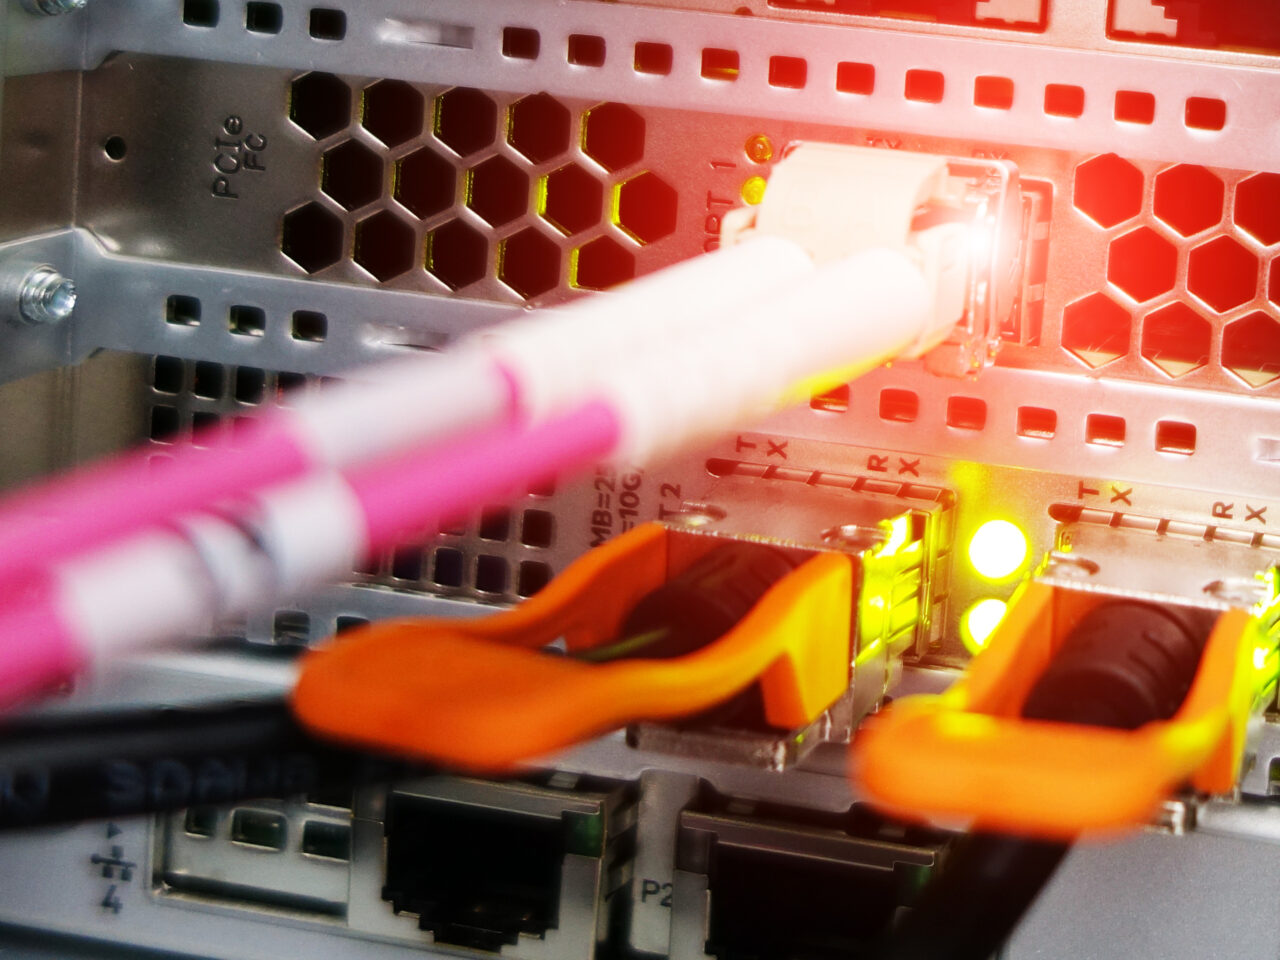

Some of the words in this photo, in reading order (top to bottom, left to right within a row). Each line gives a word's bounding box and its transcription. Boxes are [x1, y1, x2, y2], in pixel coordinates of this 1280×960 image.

[212, 115, 243, 199] PCIe
[243, 134, 267, 171] FC
[710, 161, 737, 170] 1
